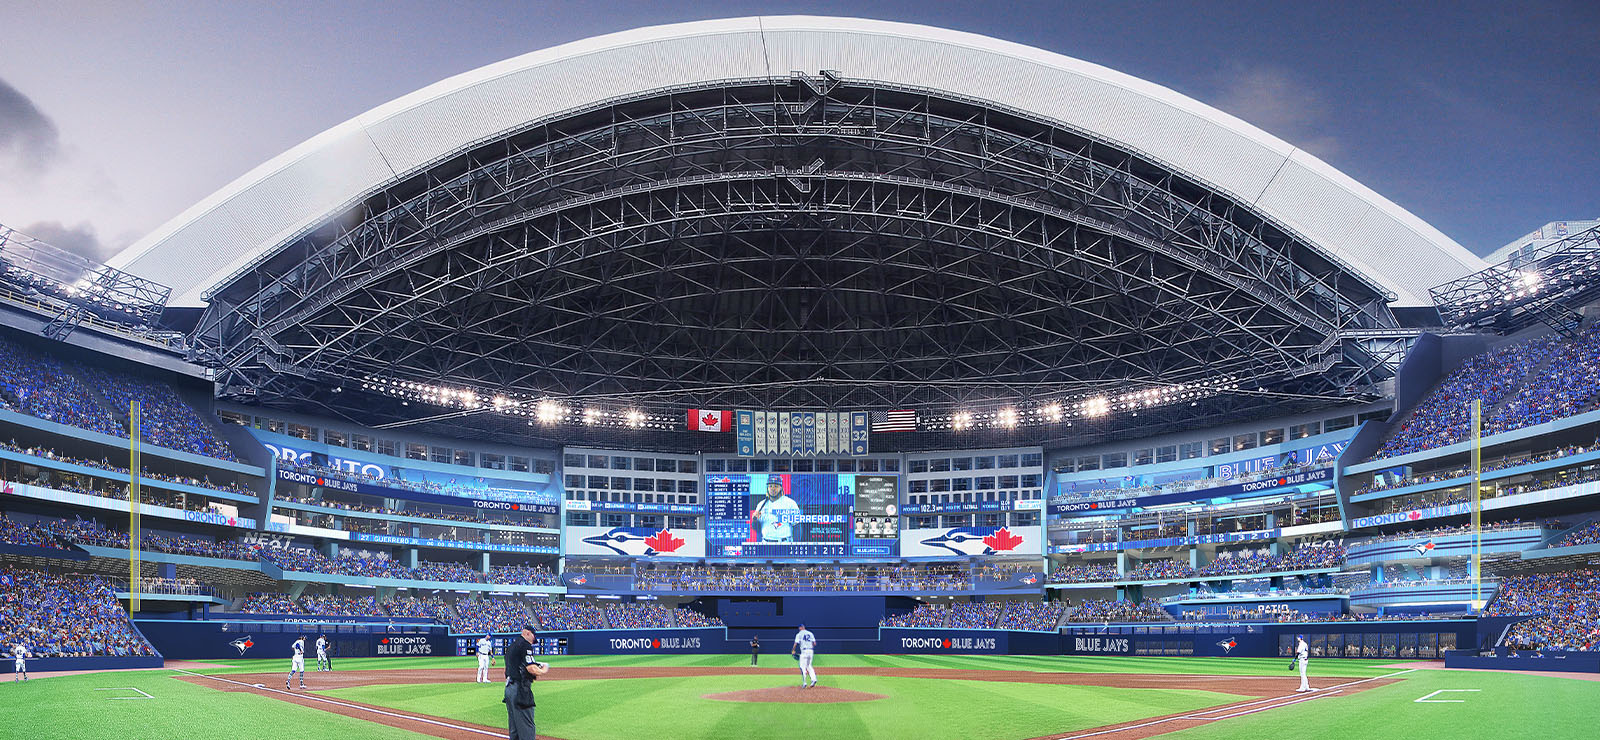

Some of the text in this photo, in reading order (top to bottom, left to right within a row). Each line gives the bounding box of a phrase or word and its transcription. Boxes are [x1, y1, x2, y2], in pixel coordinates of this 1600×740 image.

[852, 431, 867, 441] 32
[279, 469, 358, 493] TORONTO BLUE JAYS
[1241, 470, 1326, 492] TORONTO BLUE JAYS
[472, 500, 556, 513] TORONTO BLUE JAYS
[920, 504, 936, 513] 102.3
[1056, 499, 1137, 512] TORONTO BLUE JAYS
[183, 510, 227, 526] TORONTO
[781, 514, 846, 523] GUERRERO JR.
[1353, 511, 1407, 528] TORONTO
[1421, 505, 1452, 519] BLUE
[374, 536, 409, 544] GUERRERO
[823, 547, 828, 555] 2
[839, 547, 844, 555] 2
[609, 637, 701, 649] TORONTO BLUE JAYS
[901, 637, 996, 649] TORONTO BLUE JAYS
[1075, 637, 1129, 652] BLUE JAYS
[377, 644, 432, 655] BLUE JAYS
